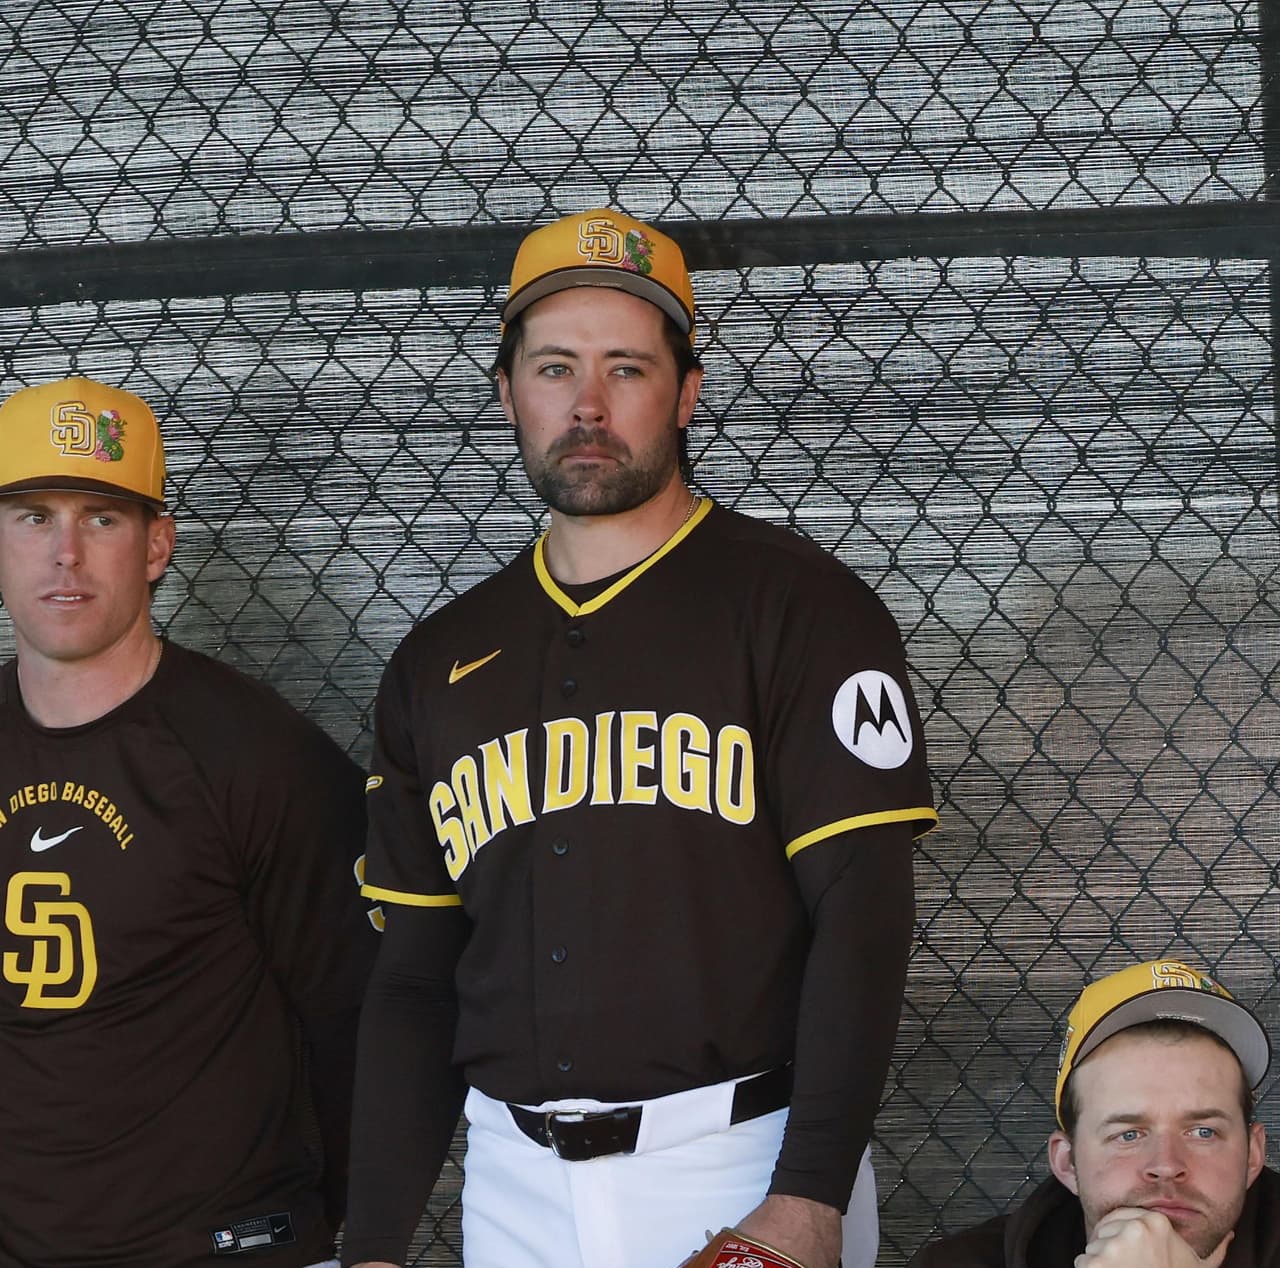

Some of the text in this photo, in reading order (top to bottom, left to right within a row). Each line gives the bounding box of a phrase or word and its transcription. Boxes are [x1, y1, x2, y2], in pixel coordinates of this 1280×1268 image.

[9, 781, 58, 814] DIEGO
[61, 781, 135, 850] BASEBALL
[428, 710, 756, 881] SAN DIEGO
[2, 871, 98, 1010] SD
